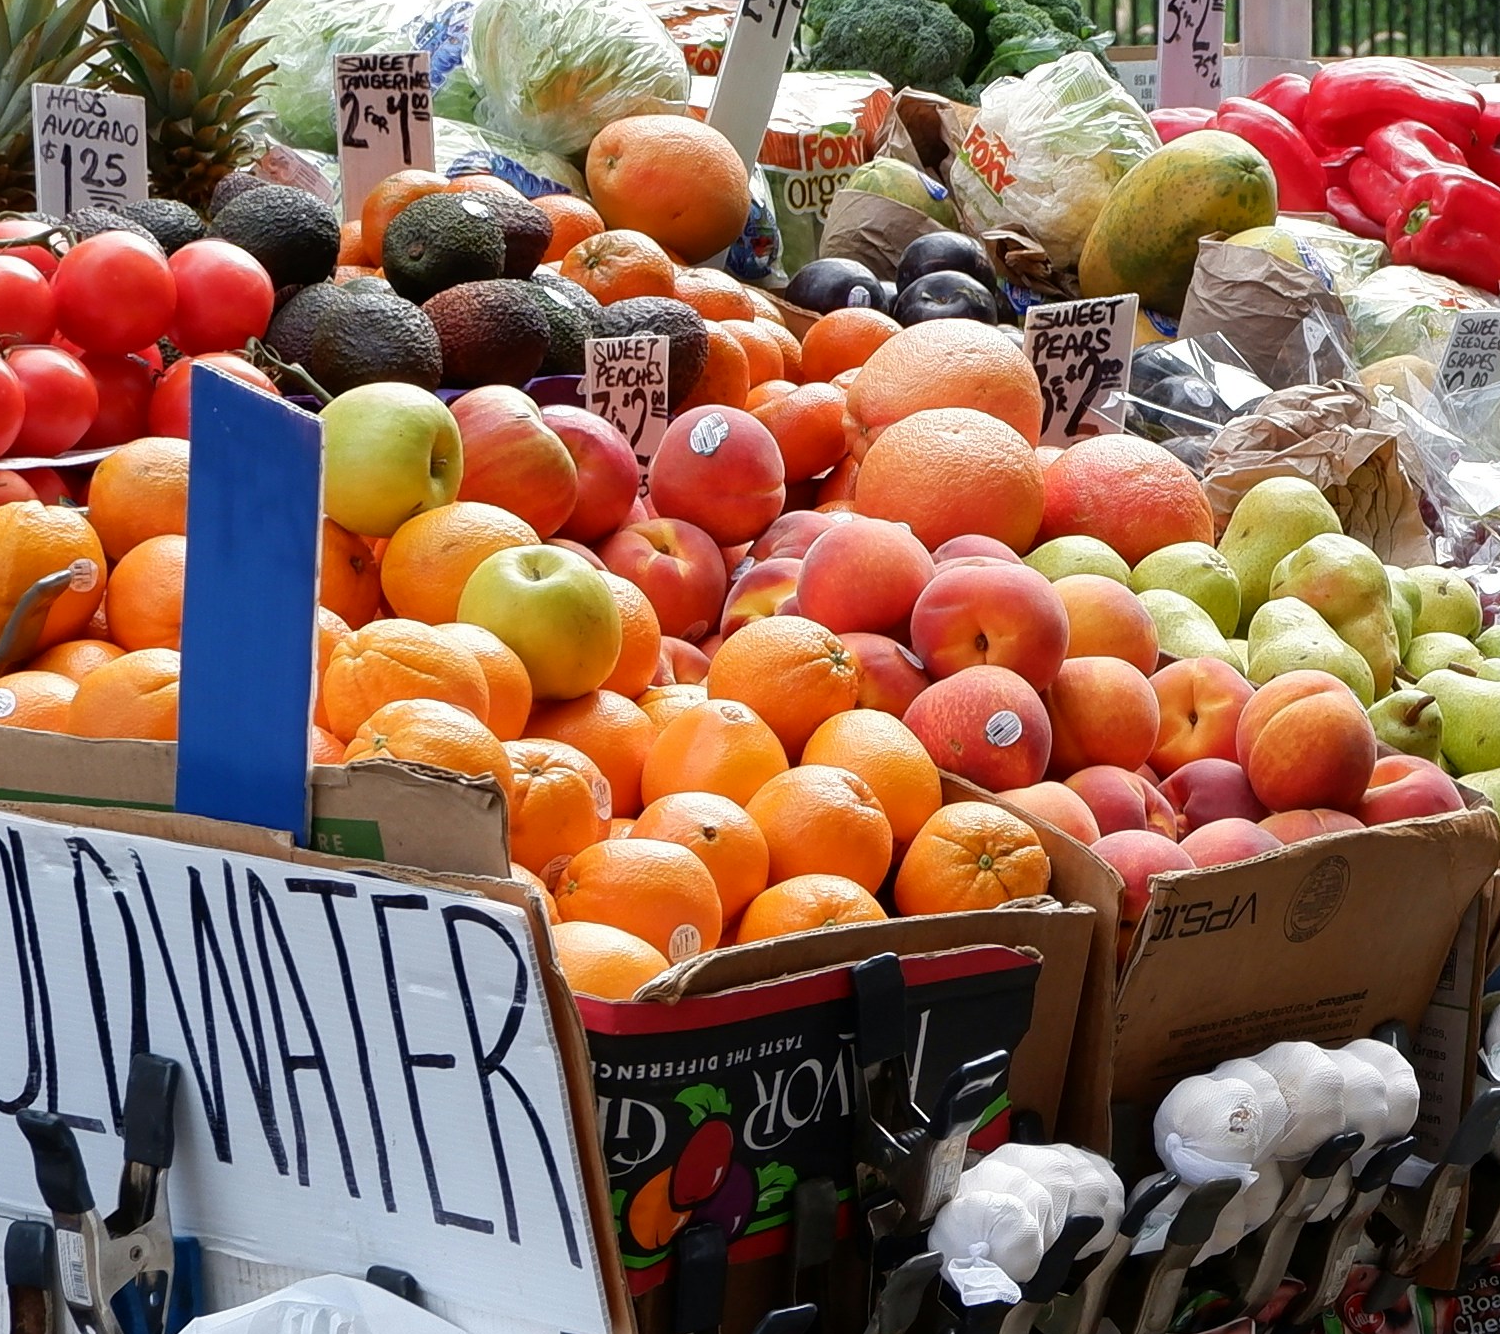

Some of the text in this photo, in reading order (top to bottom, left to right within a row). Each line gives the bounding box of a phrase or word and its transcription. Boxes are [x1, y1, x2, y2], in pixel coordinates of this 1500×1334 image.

[339, 55, 417, 74] SWEET
[46, 87, 109, 118] HASS
[40, 114, 139, 147] AVOCADO
[1032, 299, 1125, 330] SWEET
[592, 339, 659, 367] SWEET
[1032, 327, 1112, 364] PEARS
[594, 363, 664, 389] PEACHES
[133, 843, 584, 1270] WATER
[725, 1032, 805, 1069] TASTE THE
